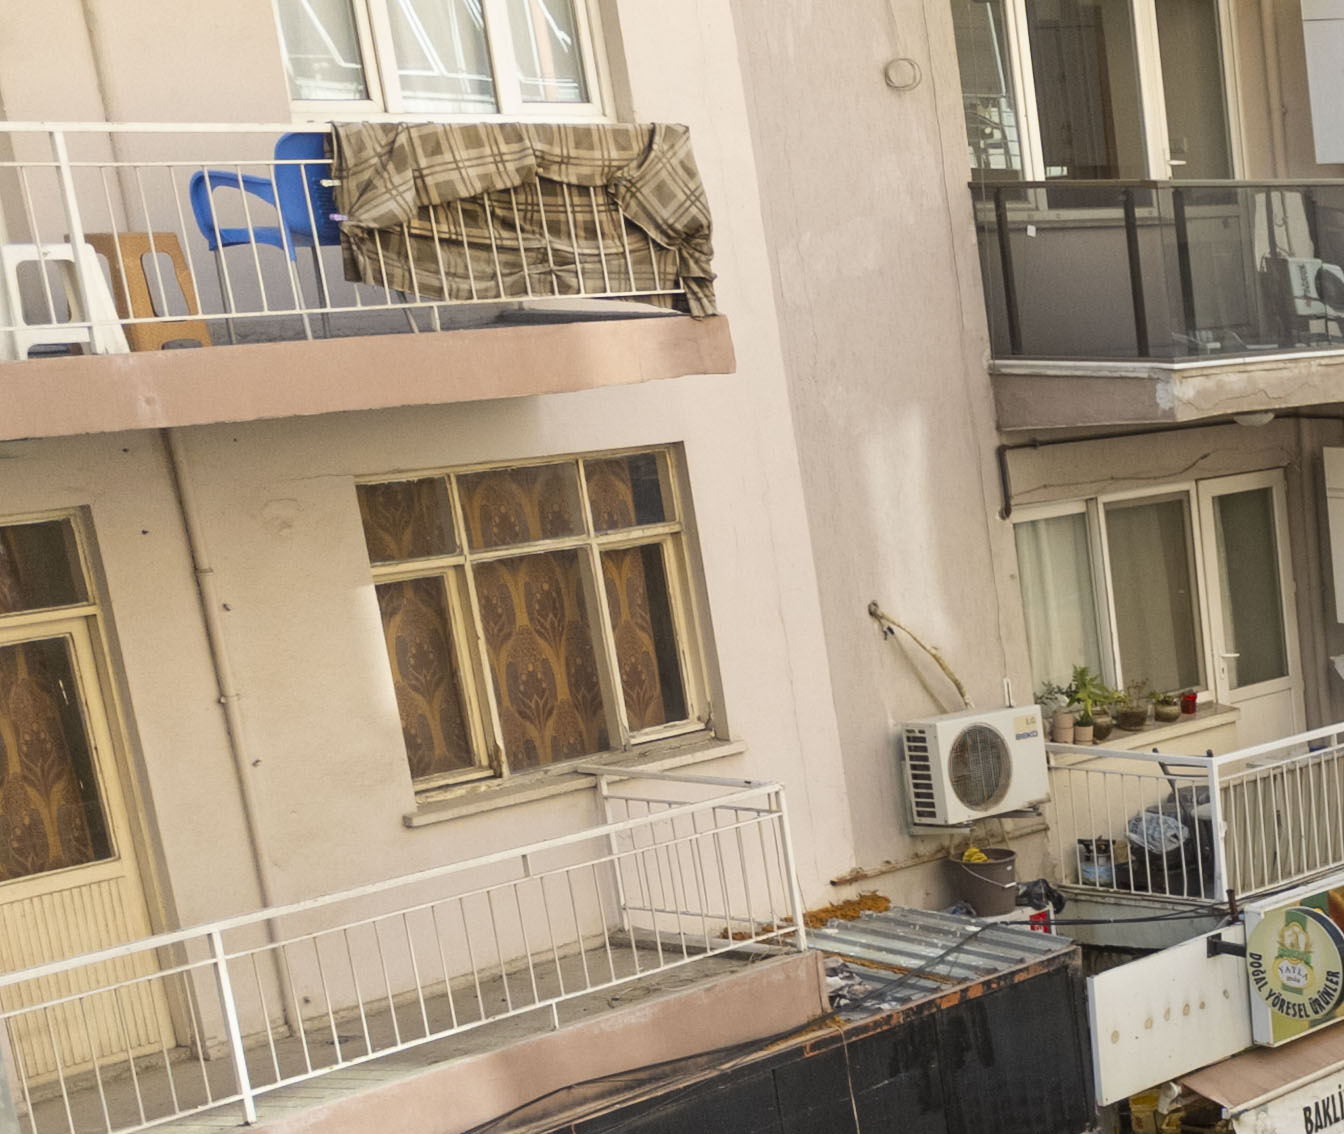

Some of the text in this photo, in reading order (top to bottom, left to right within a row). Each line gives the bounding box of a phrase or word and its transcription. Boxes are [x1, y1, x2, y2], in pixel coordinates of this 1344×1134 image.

[1249, 951, 1341, 1019] DOĞAL YÖRESEL ÜRÜNLER
